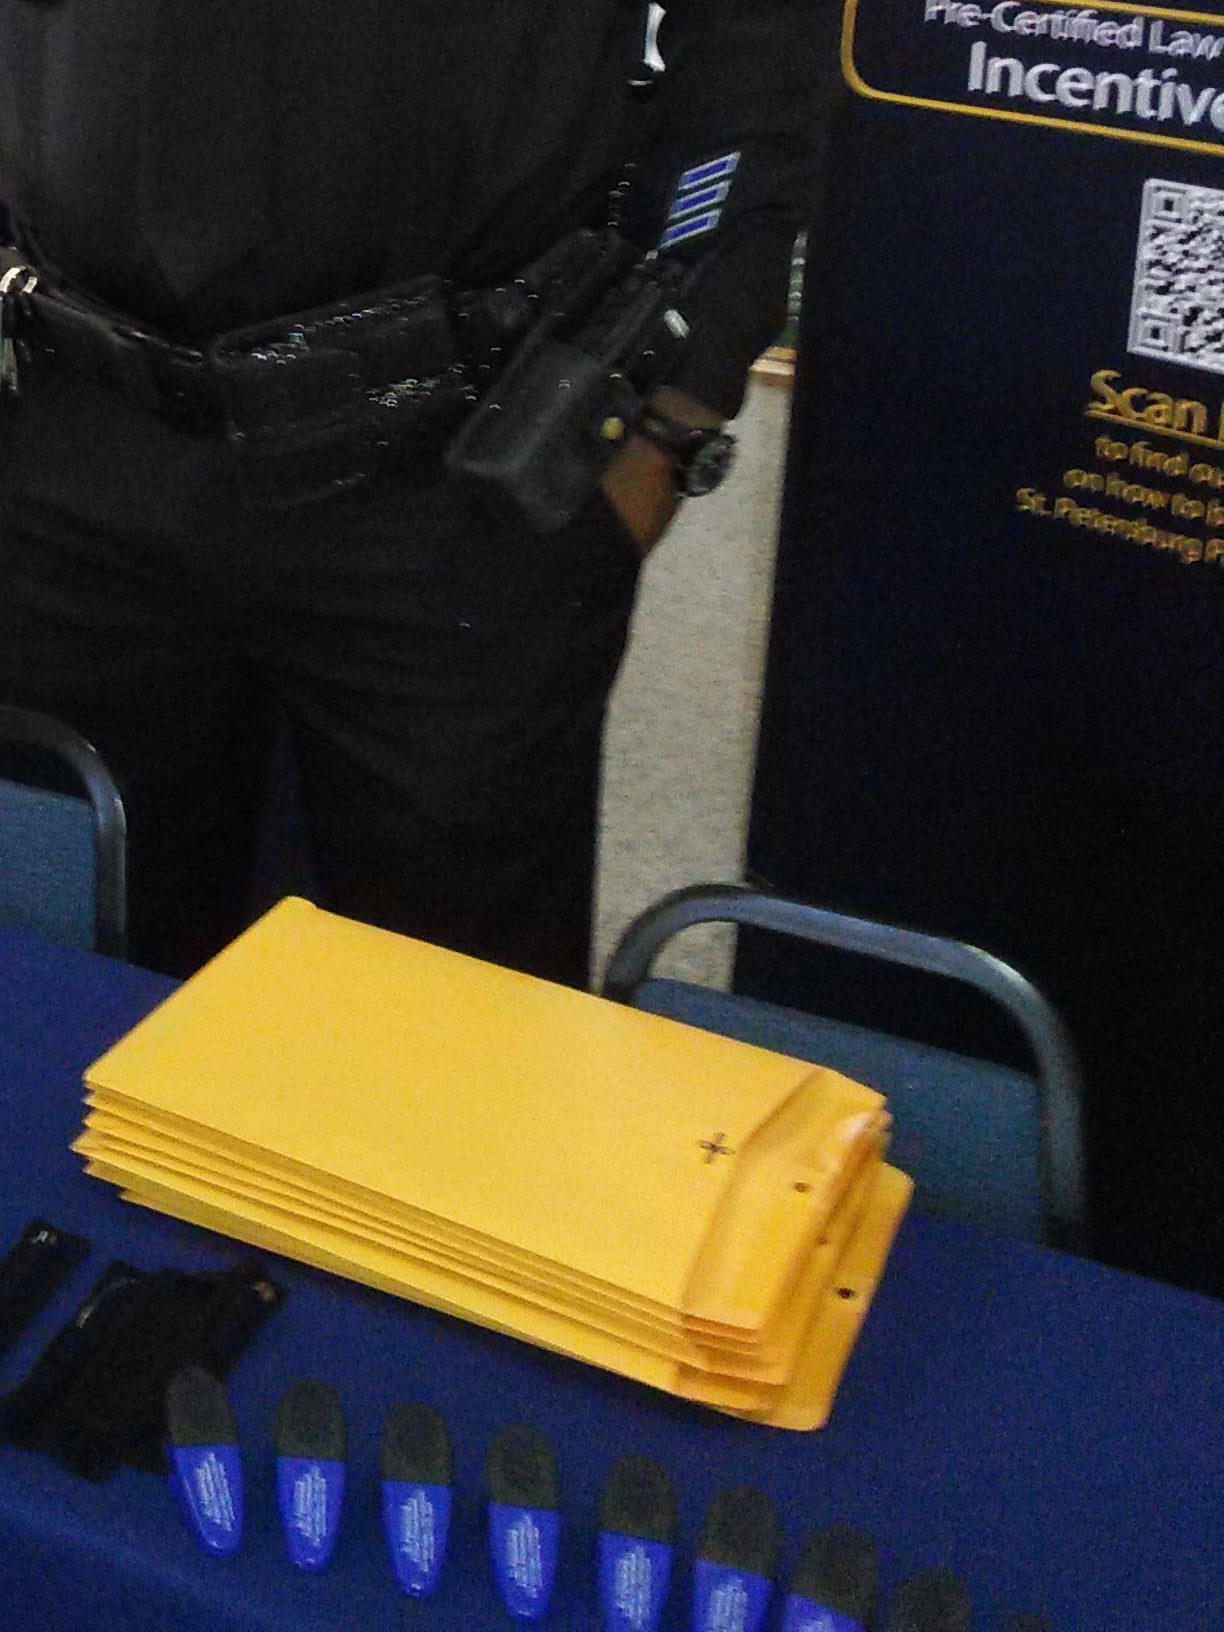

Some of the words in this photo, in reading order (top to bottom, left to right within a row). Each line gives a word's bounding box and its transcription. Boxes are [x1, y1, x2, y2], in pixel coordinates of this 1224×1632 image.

[1148, 20, 1224, 60] Law
[1085, 369, 1208, 434] Scan
[1095, 436, 1127, 461] to
[1129, 441, 1189, 477] find
[1063, 469, 1105, 493] on
[1105, 472, 1170, 509] how
[1171, 493, 1206, 519] to
